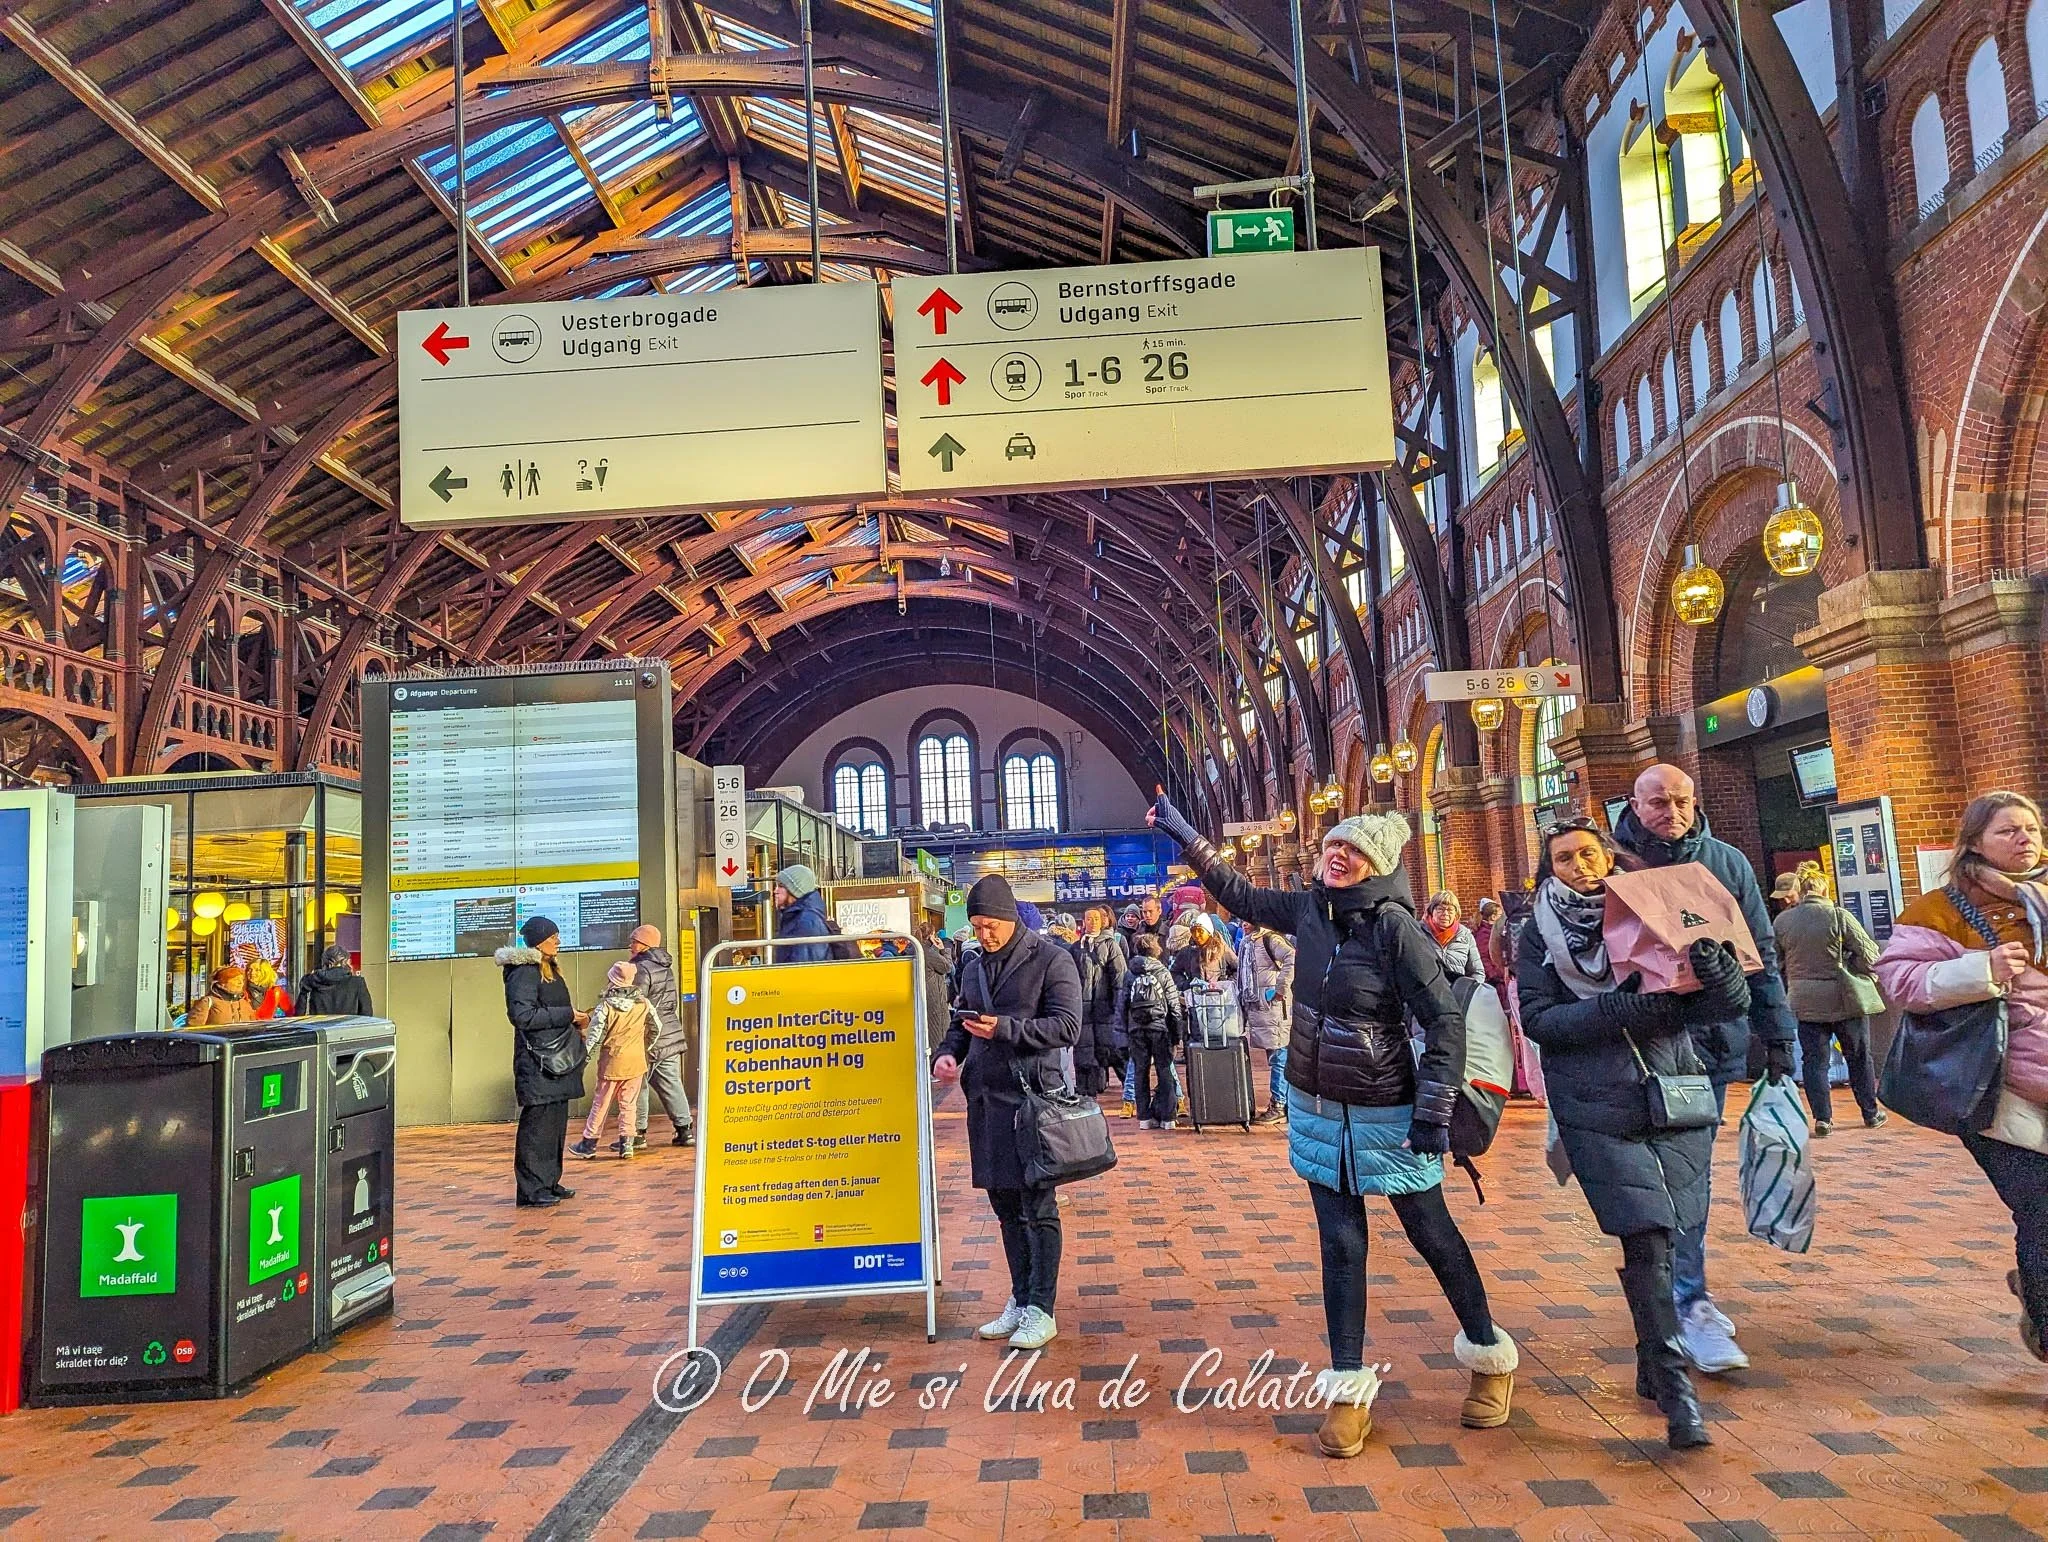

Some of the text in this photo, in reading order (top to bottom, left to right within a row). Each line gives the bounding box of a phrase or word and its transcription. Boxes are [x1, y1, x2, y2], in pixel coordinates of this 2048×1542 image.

[1058, 271, 1236, 299] Bernstorffsgade
[562, 306, 718, 331] Vesterbrogade
[1059, 303, 1179, 325] Udgang Exit
[563, 335, 679, 358] Udgang Exit
[1152, 338, 1187, 348] 15 min.
[1065, 352, 1189, 387] 1-6 26
[1065, 390, 1108, 400] Spor Track
[1145, 385, 1167, 394] Spor
[1466, 676, 1515, 690] 5-6 26
[410, 688, 478, 697] Afgange Departures
[717, 777, 740, 790] 5-6
[720, 805, 738, 817] 26
[1108, 884, 1157, 897] TUBE
[840, 902, 879, 916] KYLLING
[840, 913, 887, 928] FOCACCIA
[233, 933, 273, 945] TOASTIES
[751, 989, 781, 997] Trafikinfo
[726, 1008, 884, 1033] Ingen InterCity- og
[726, 1028, 896, 1054] regionaltog mellem
[725, 1052, 864, 1074] København H og
[724, 1076, 811, 1096] Østerport
[723, 1097, 882, 1114] No InterCity and regional trains between
[723, 1107, 860, 1124] Copenhagen Central and Østerport
[724, 1132, 901, 1153] Benyt i stedet S-tog eller Metro
[723, 1157, 748, 1166] Please
[763, 1155, 776, 1164] the
[776, 1154, 804, 1163] S-trains
[815, 1152, 827, 1160] the
[828, 1151, 849, 1160] Metro
[723, 1175, 881, 1193] Fra sent fredag aften den 5. januar
[723, 1187, 865, 1206] til og med søndag den 7. januar
[348, 1215, 374, 1235] Restaffald
[259, 1248, 290, 1270] Madaffald
[853, 1254, 884, 1269] DOT
[99, 1272, 158, 1286] Madaffald
[236, 1293, 264, 1311] Må vi tage
[236, 1296, 277, 1324] skraldet for dig?
[56, 1345, 103, 1356] Må vi tage
[176, 1347, 193, 1355] DSB
[55, 1355, 129, 1369] skraldet for dig?
